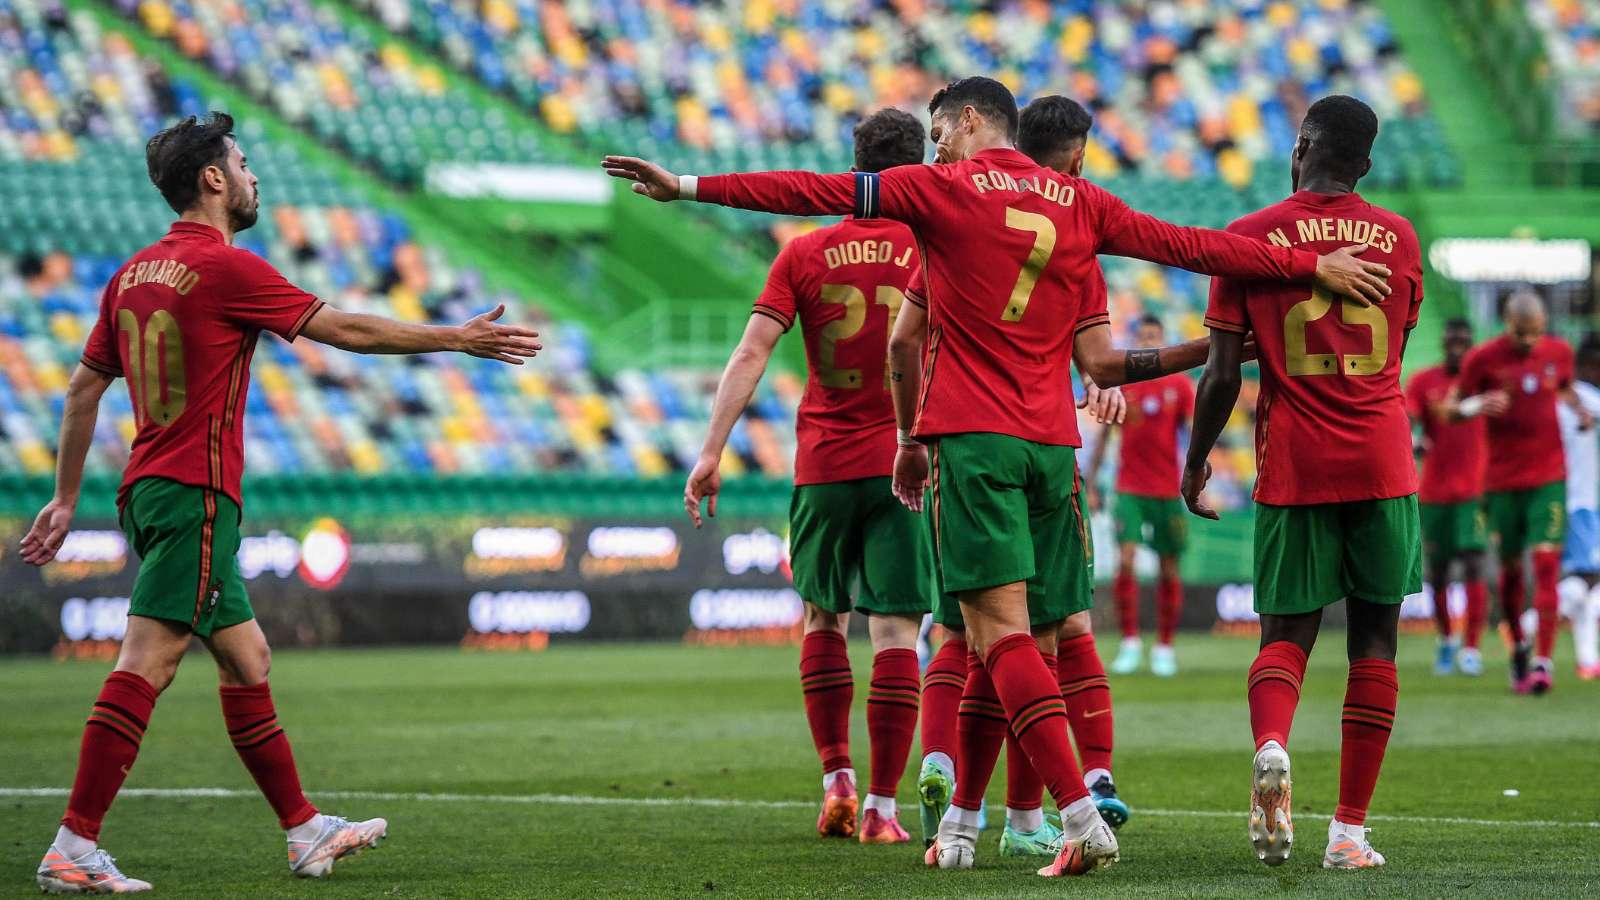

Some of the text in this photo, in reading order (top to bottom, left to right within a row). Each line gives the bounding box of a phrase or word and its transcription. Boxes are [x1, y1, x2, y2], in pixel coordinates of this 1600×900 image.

[972, 170, 1075, 207] RONALDO
[823, 240, 913, 269] DIOGO J.
[1001, 206, 1057, 322] 7
[1267, 218, 1397, 253] N. MENDES
[1284, 264, 1389, 377] 25
[118, 308, 187, 427] 10
